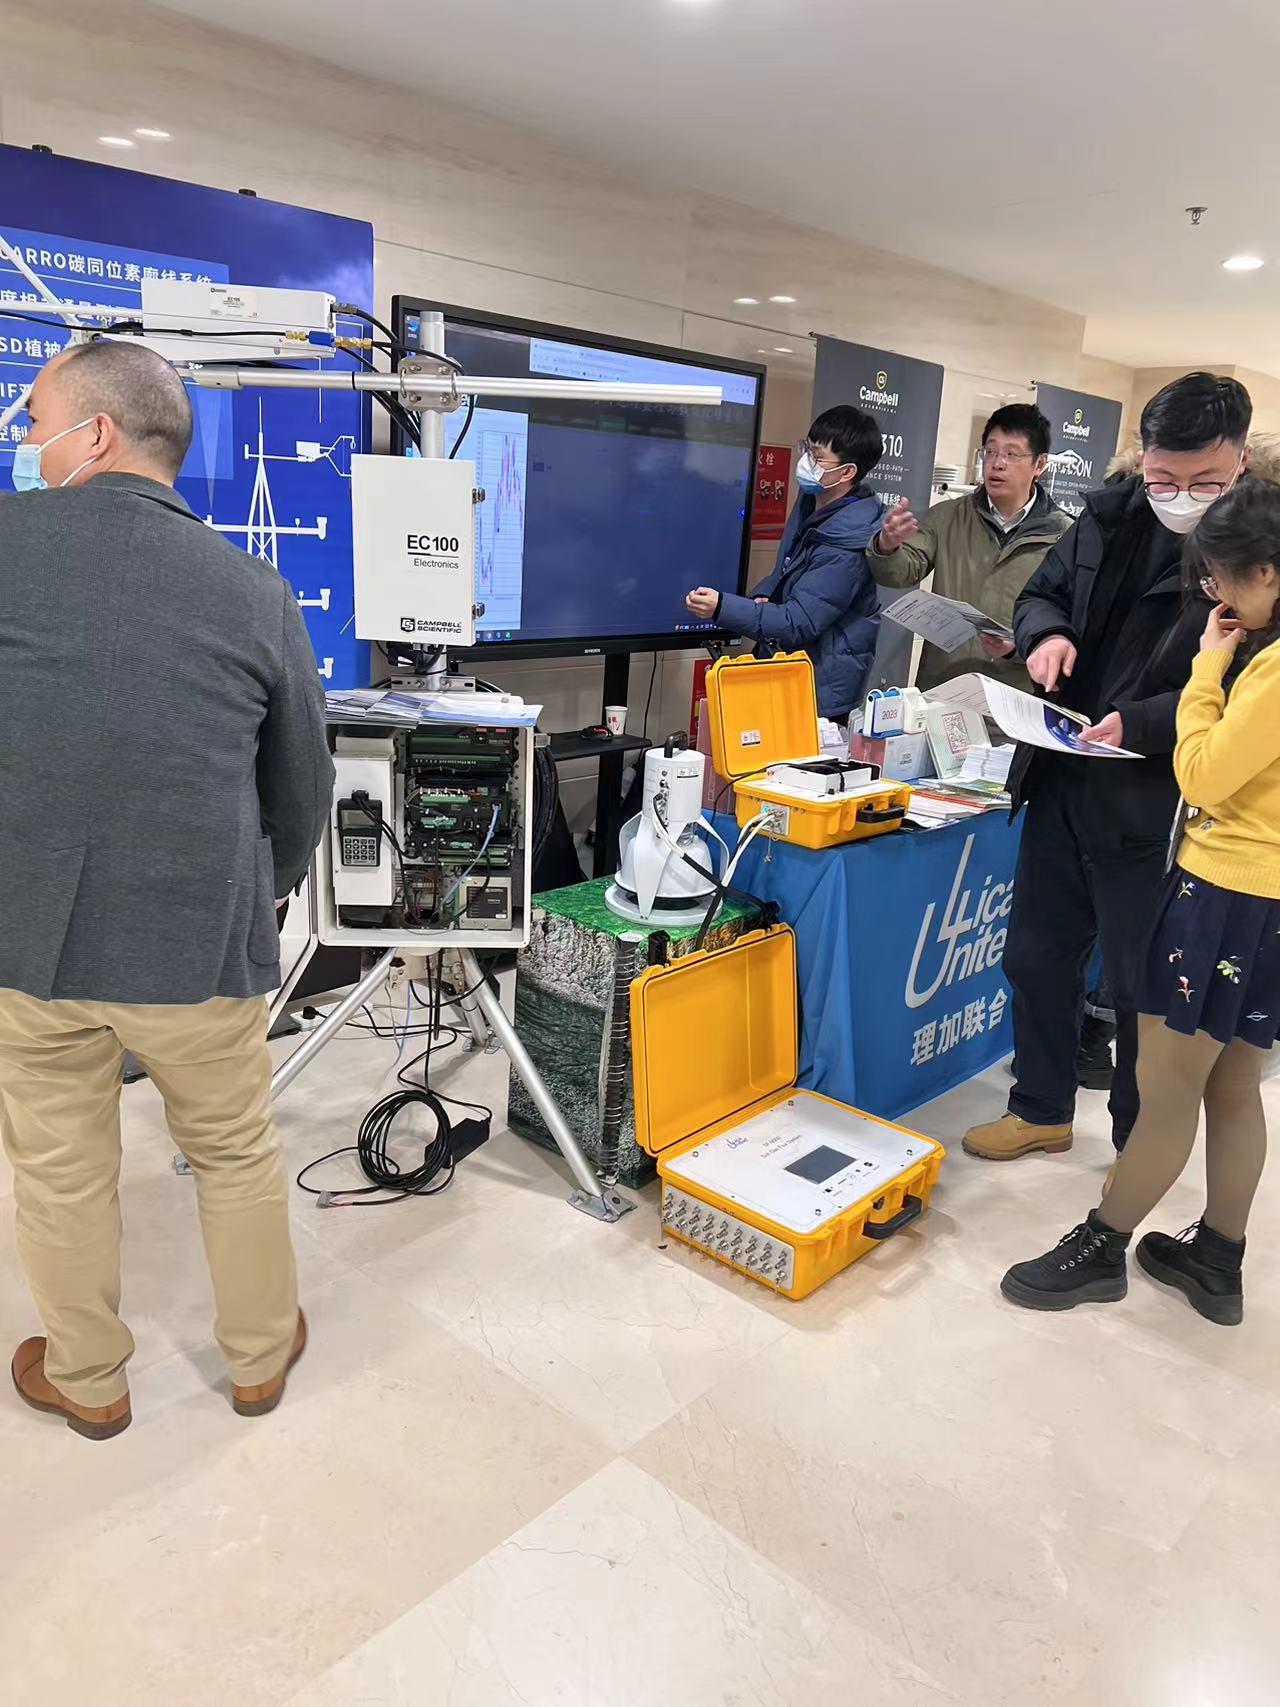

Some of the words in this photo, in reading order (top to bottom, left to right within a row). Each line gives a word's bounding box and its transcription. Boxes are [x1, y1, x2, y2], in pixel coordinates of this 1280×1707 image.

[0, 336, 70, 359] SD植被
[859, 385, 899, 407] Campbell
[1062, 421, 1090, 437] Campbell
[407, 534, 459, 552] EC100
[413, 558, 459, 569] Electronics
[417, 620, 462, 628] CAMPBELL
[417, 626, 462, 634] SCIENTIFIC
[911, 988, 1008, 1066] 理加联合
